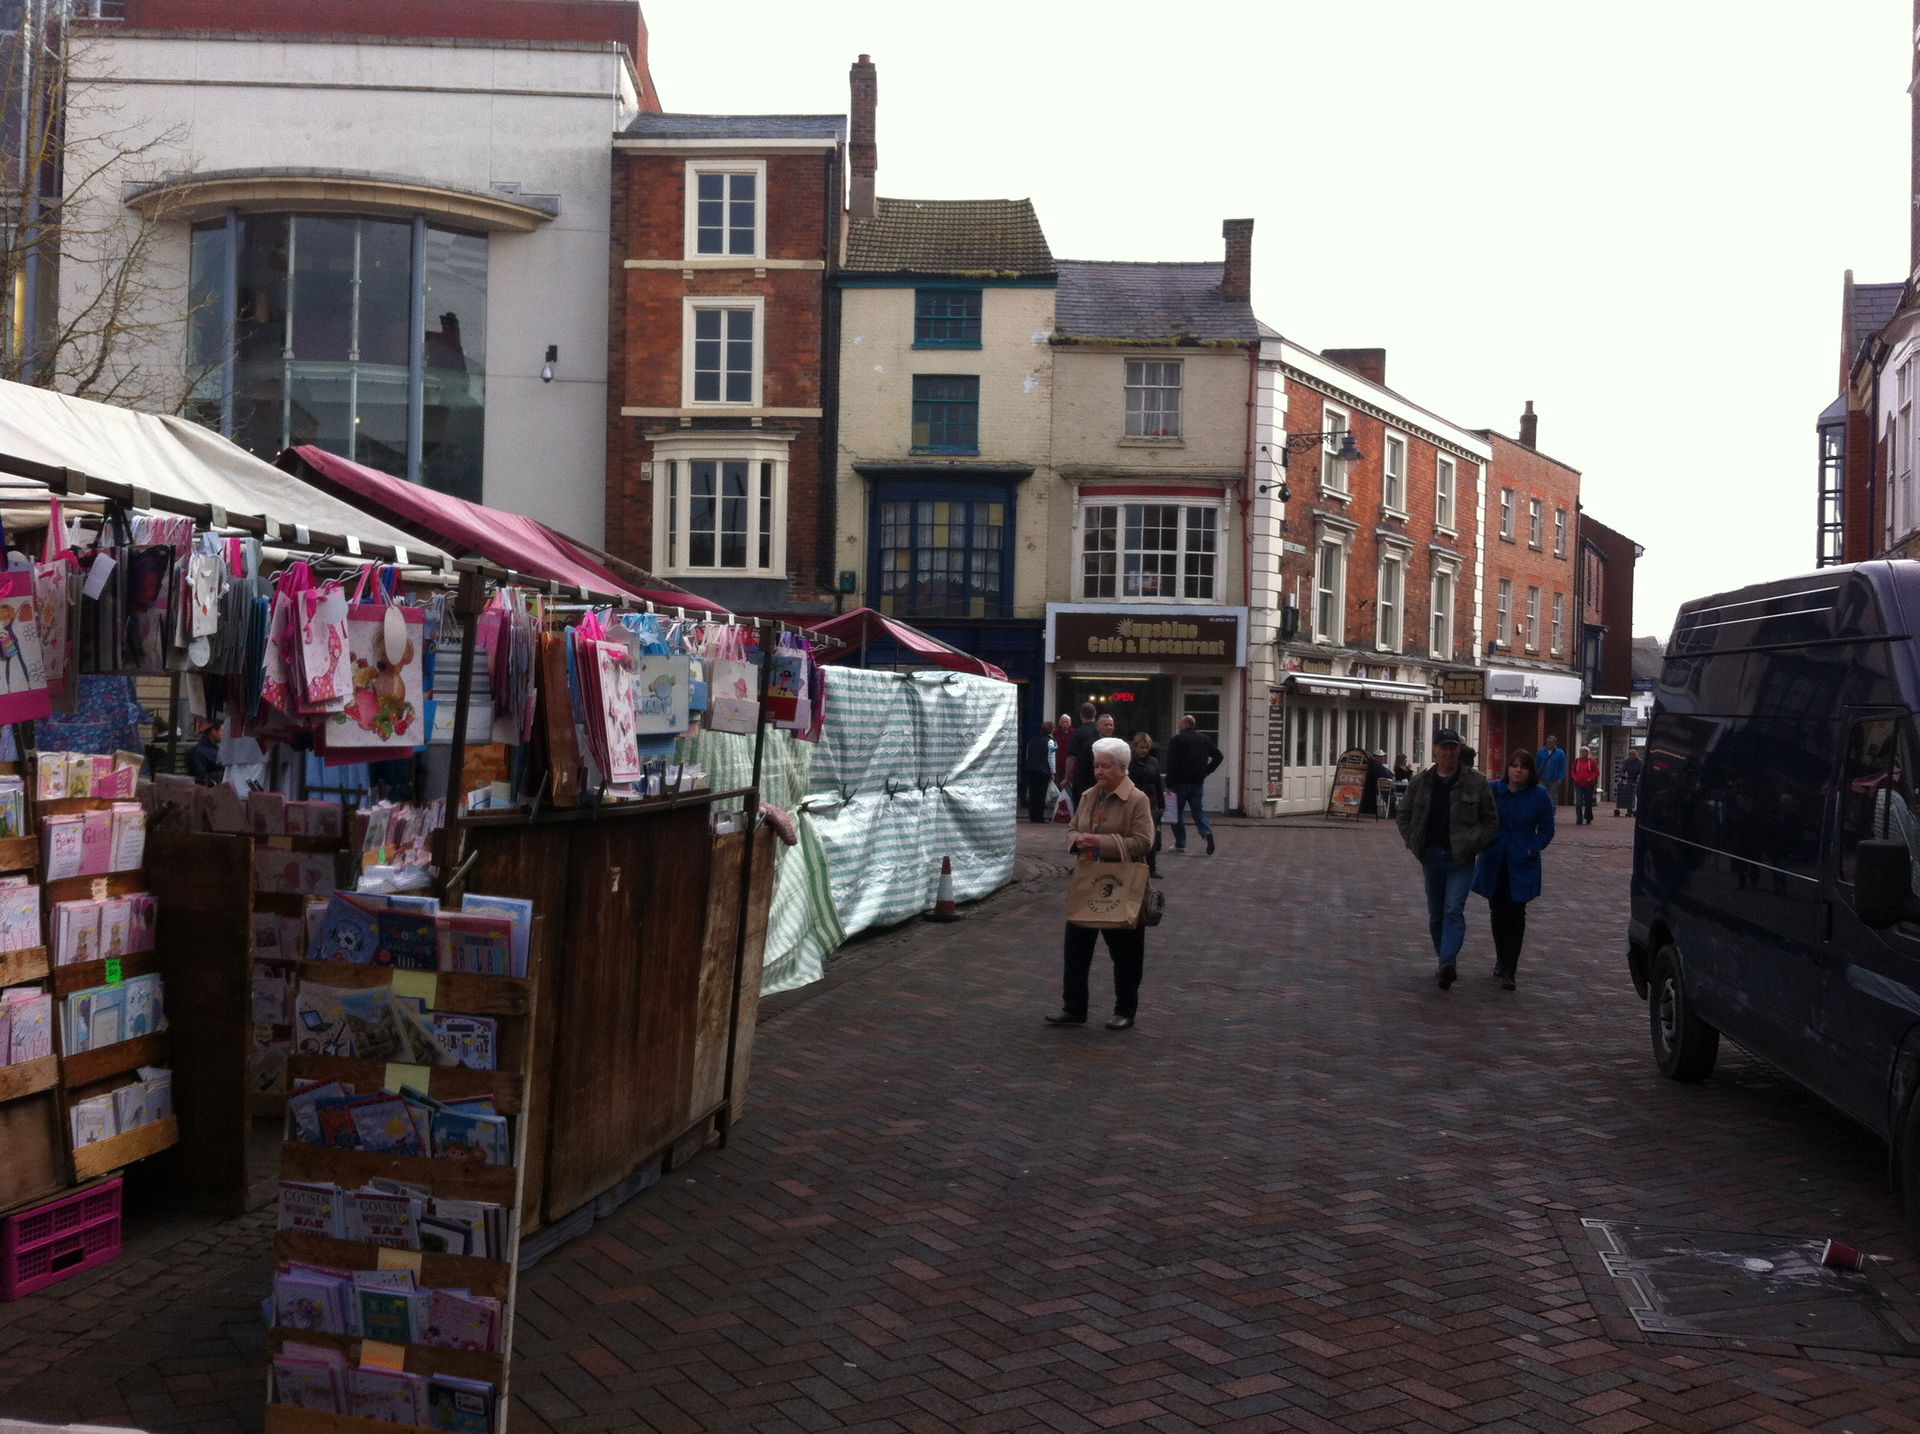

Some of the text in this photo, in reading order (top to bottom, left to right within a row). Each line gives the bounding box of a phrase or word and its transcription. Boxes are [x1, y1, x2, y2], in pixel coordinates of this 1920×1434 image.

[1121, 620, 1199, 639] Sunshine
[1088, 636, 1225, 655] Café & Restaurant
[1112, 692, 1135, 702] OPEN
[284, 1190, 330, 1206] COUSIN
[360, 1199, 407, 1214] COUSIN
